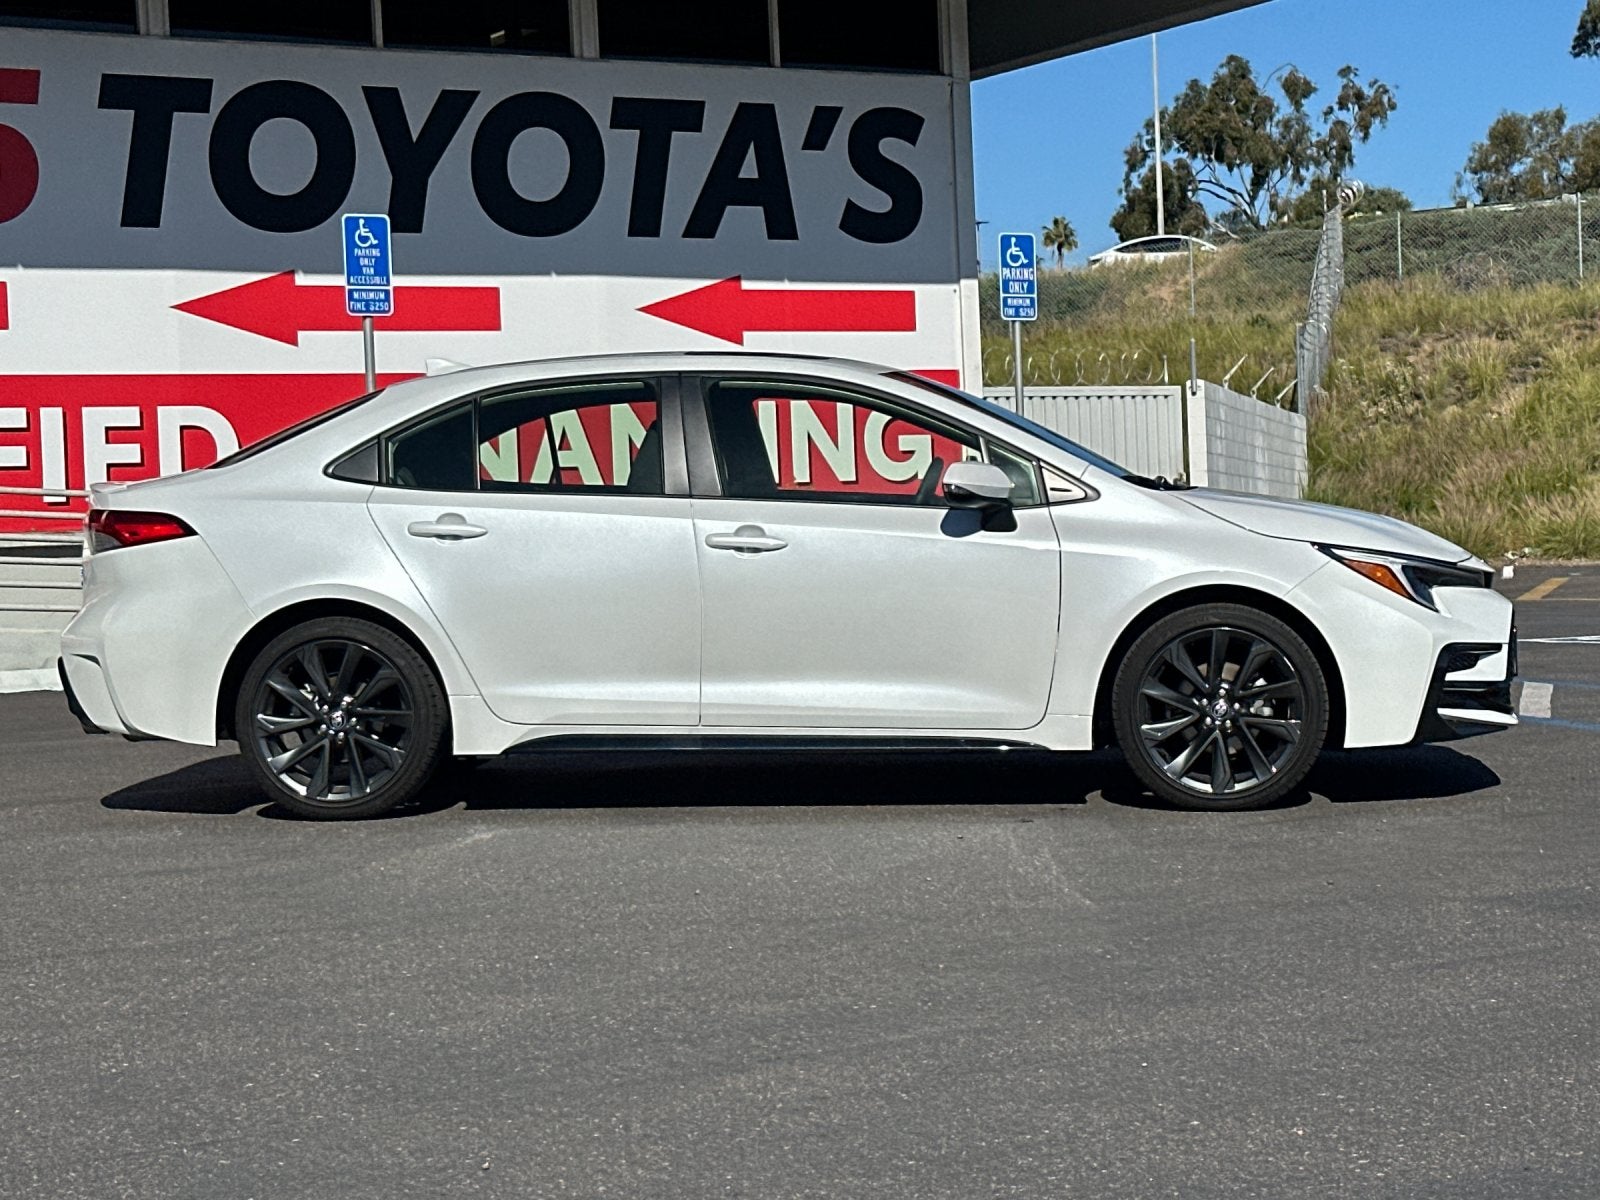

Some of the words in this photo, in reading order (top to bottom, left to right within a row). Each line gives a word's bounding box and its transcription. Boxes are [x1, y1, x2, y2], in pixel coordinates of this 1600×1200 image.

[98, 73, 926, 244] TOYOTA'S
[354, 248, 380, 257] PARKING
[359, 257, 376, 266] ONLY
[362, 267, 374, 275] VAN
[1002, 267, 1033, 280] PARKING
[349, 275, 387, 285] ACCESSIBLE
[1009, 281, 1028, 293] ONLY
[353, 291, 385, 300] MINIMUM
[350, 301, 366, 311] FINE
[369, 301, 389, 311] $250
